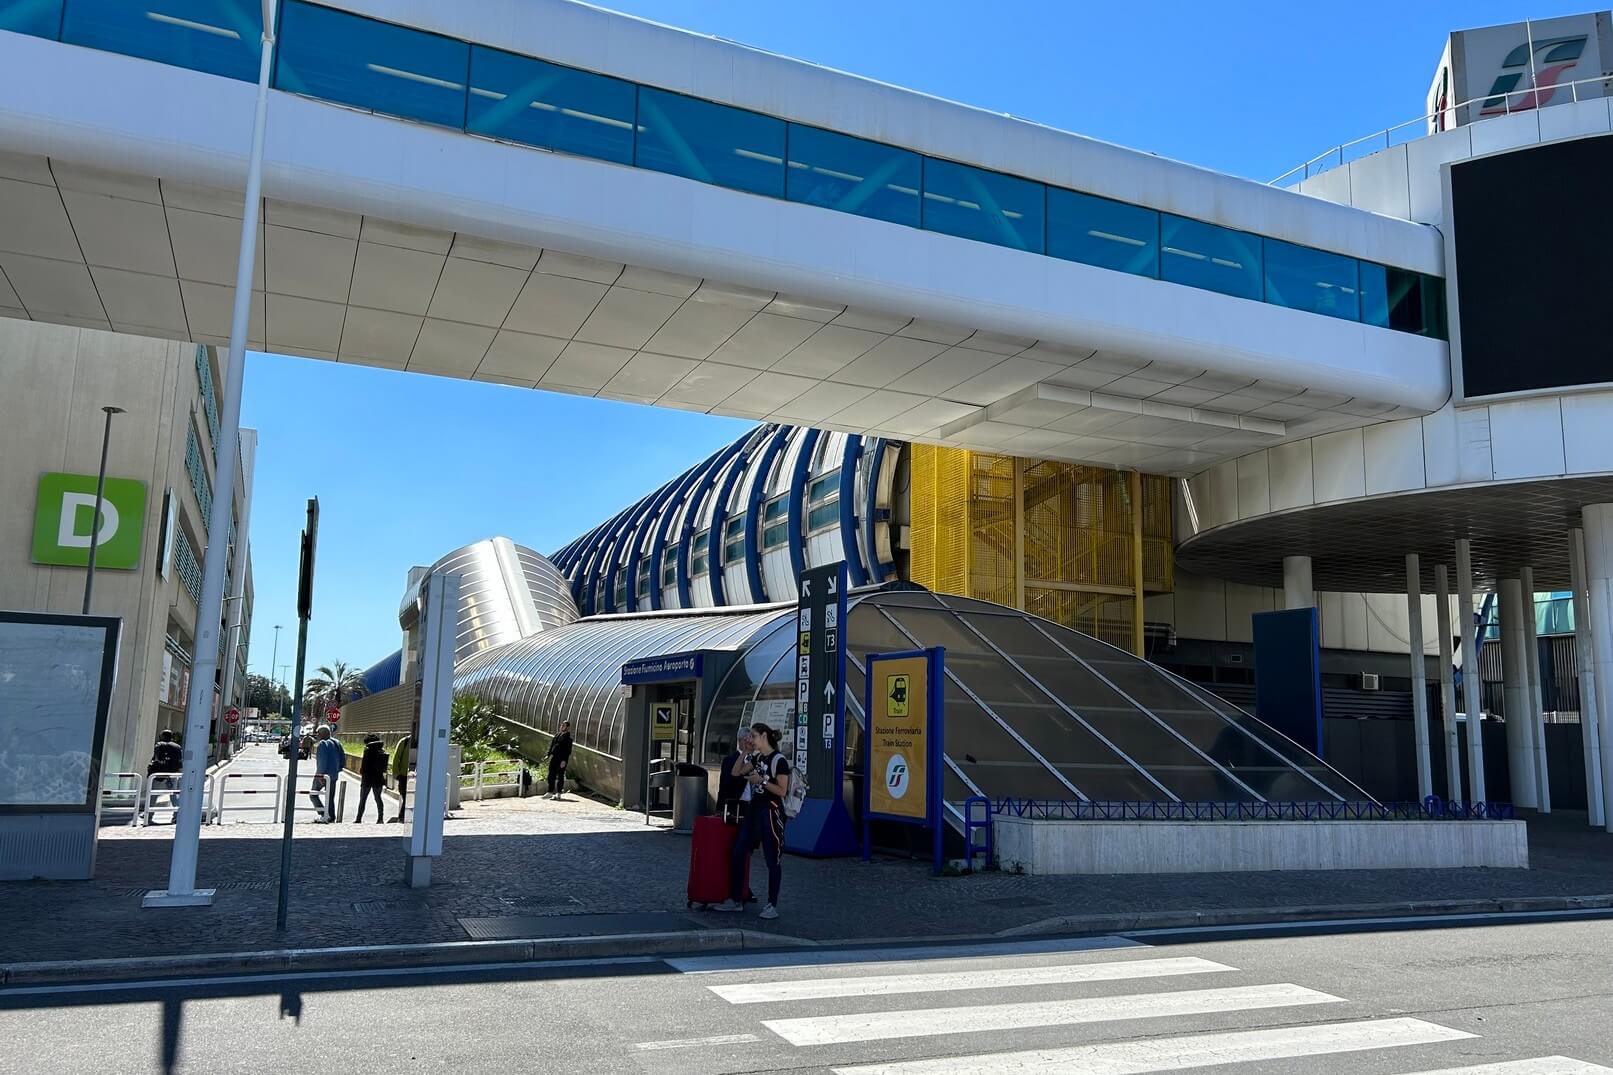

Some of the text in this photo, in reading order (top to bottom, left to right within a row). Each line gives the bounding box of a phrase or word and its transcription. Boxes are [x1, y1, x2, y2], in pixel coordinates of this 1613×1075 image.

[58, 491, 119, 548] D
[826, 634, 835, 647] T3
[664, 659, 689, 671] Aeroporto
[800, 682, 807, 700] P
[825, 715, 832, 732] P
[824, 739, 832, 749] T3
